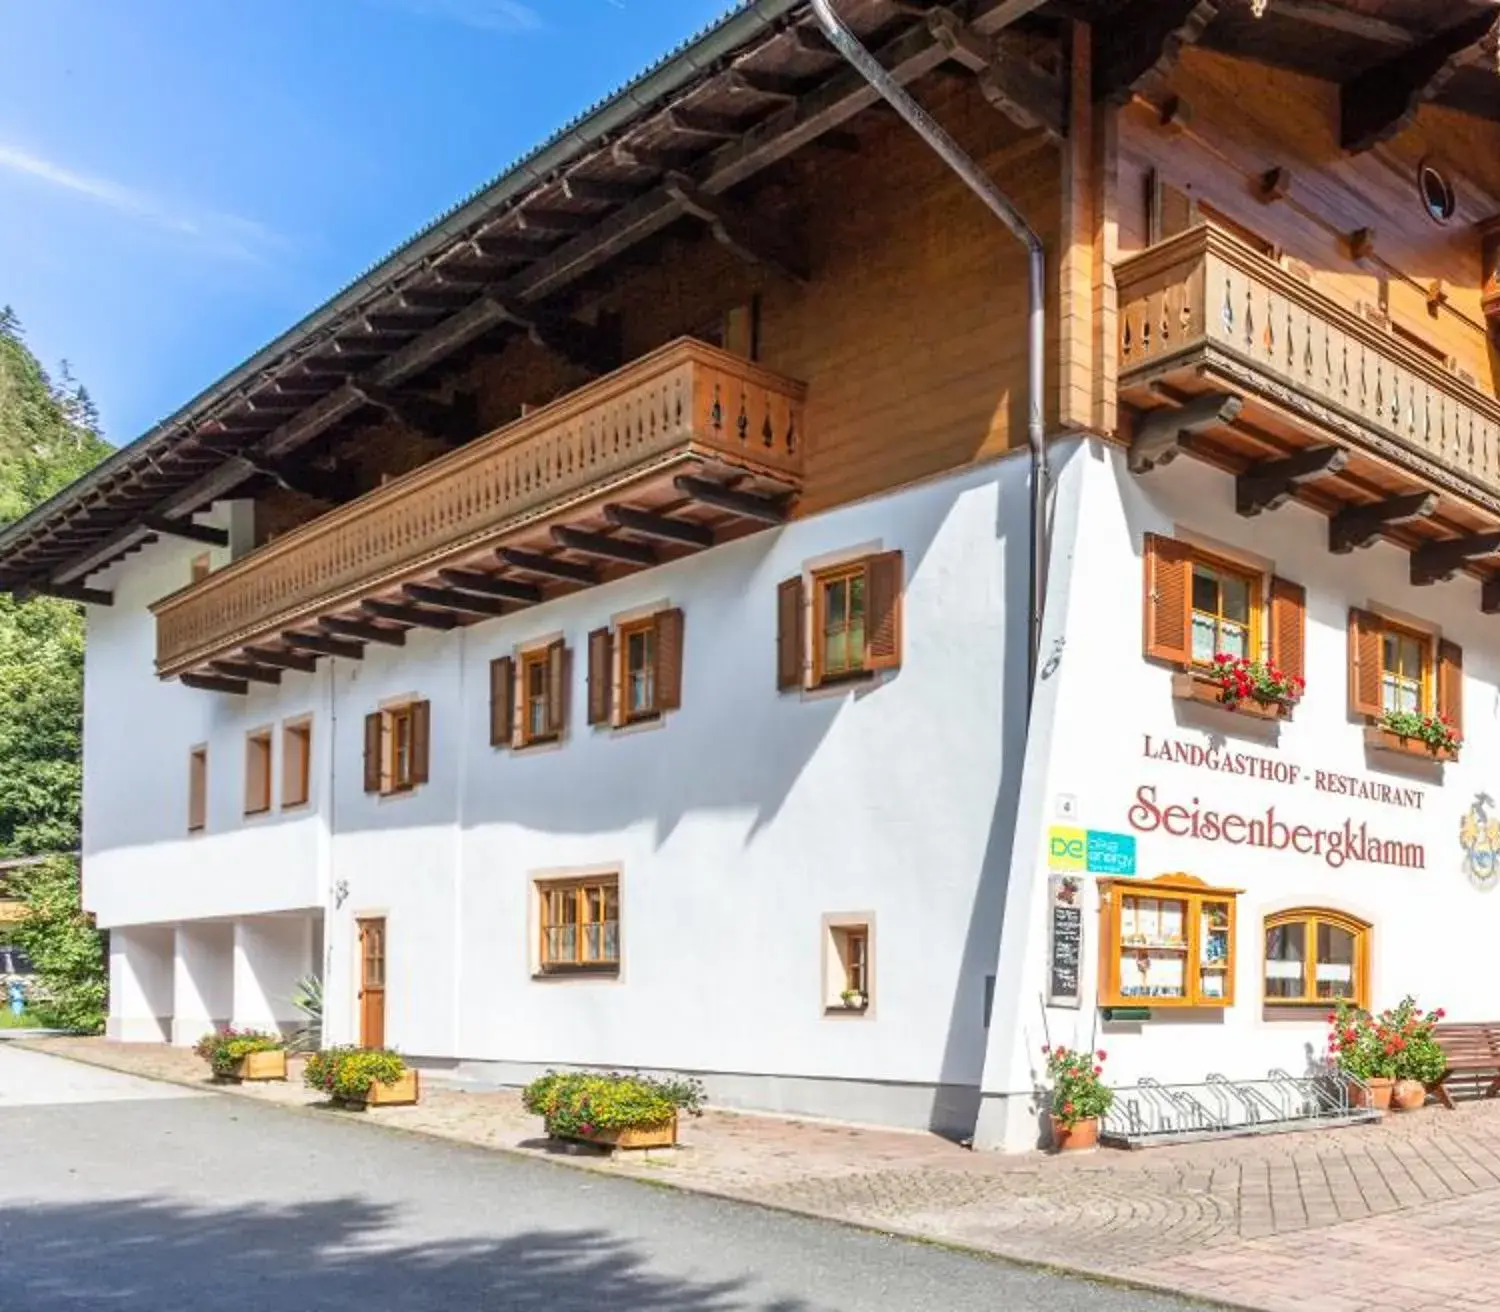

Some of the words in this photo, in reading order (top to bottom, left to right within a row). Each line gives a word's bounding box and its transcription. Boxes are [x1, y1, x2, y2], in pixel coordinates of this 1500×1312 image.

[1143, 735, 1300, 785] LANDGASTHOF
[1314, 769, 1425, 810] RESTAURANT
[1127, 784, 1426, 869] Seisenbergklamm
